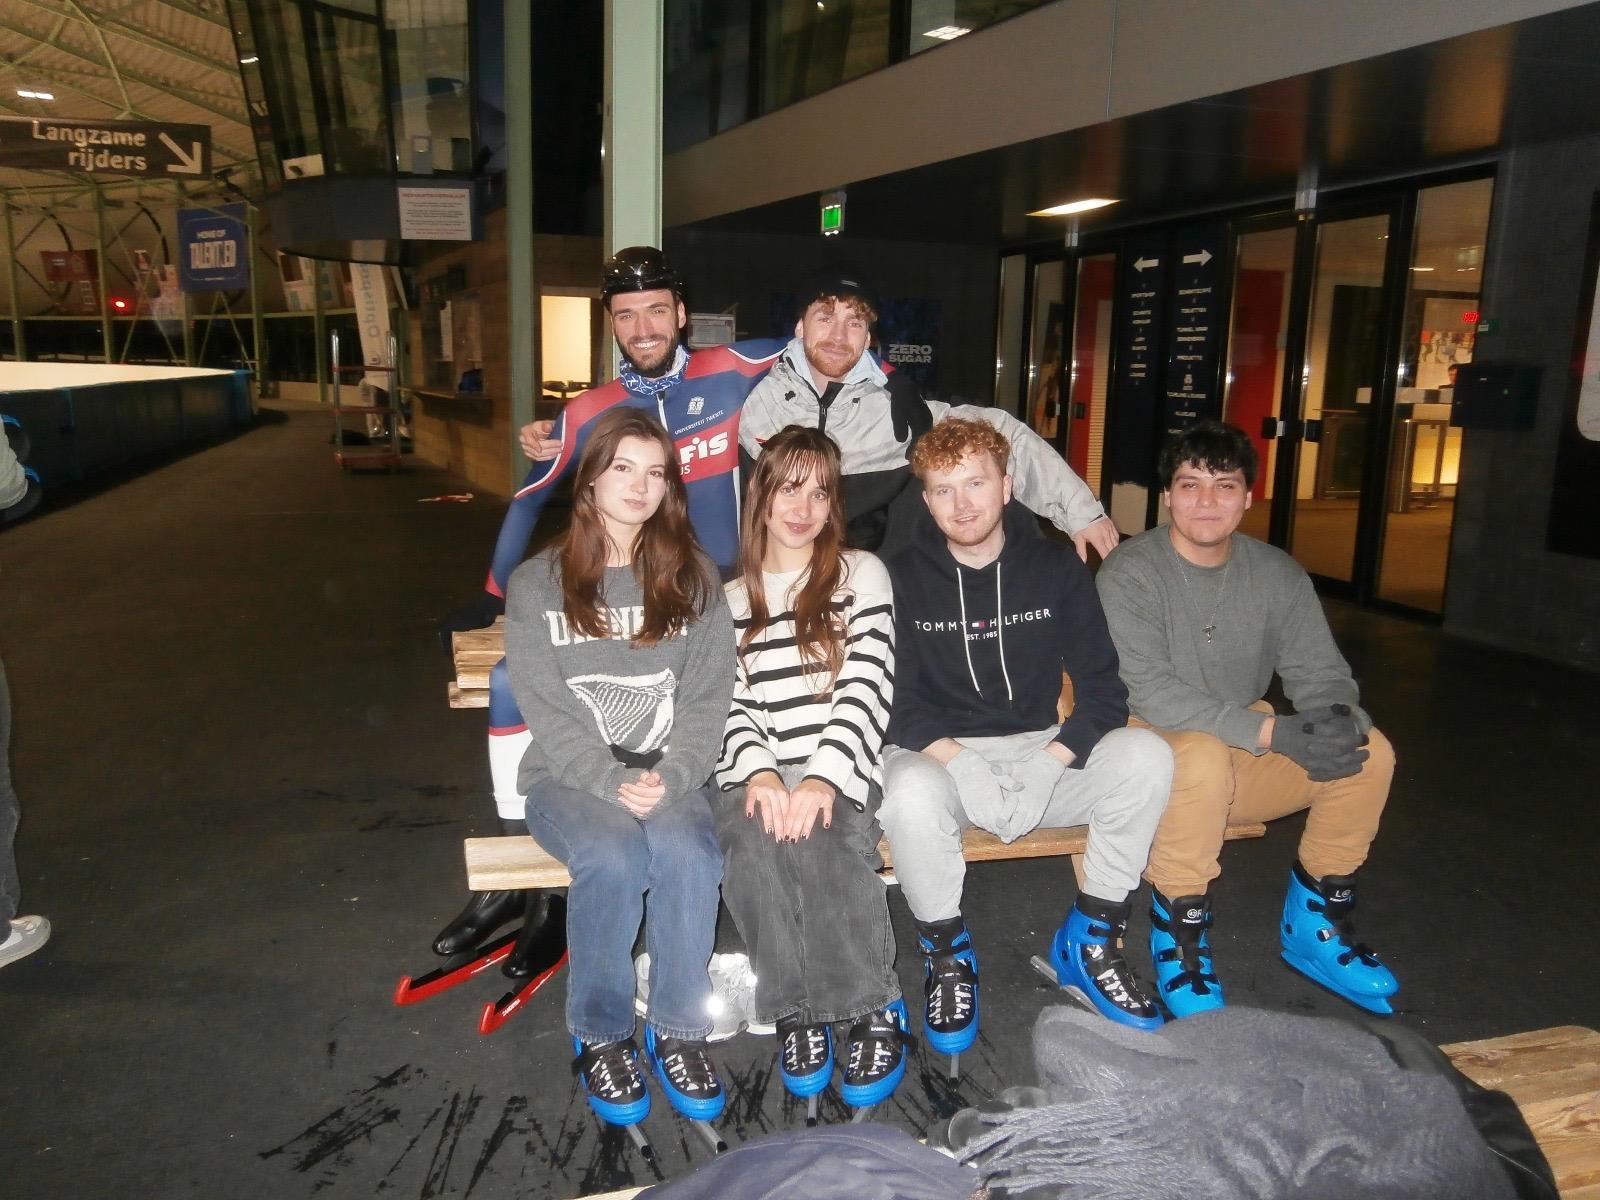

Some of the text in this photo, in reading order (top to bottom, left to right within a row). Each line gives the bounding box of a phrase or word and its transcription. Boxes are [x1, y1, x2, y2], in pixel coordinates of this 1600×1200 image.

[32, 120, 146, 147] Langzame
[68, 148, 147, 171] rijders
[888, 344, 933, 354] ZERO
[888, 354, 932, 363] SUGAR
